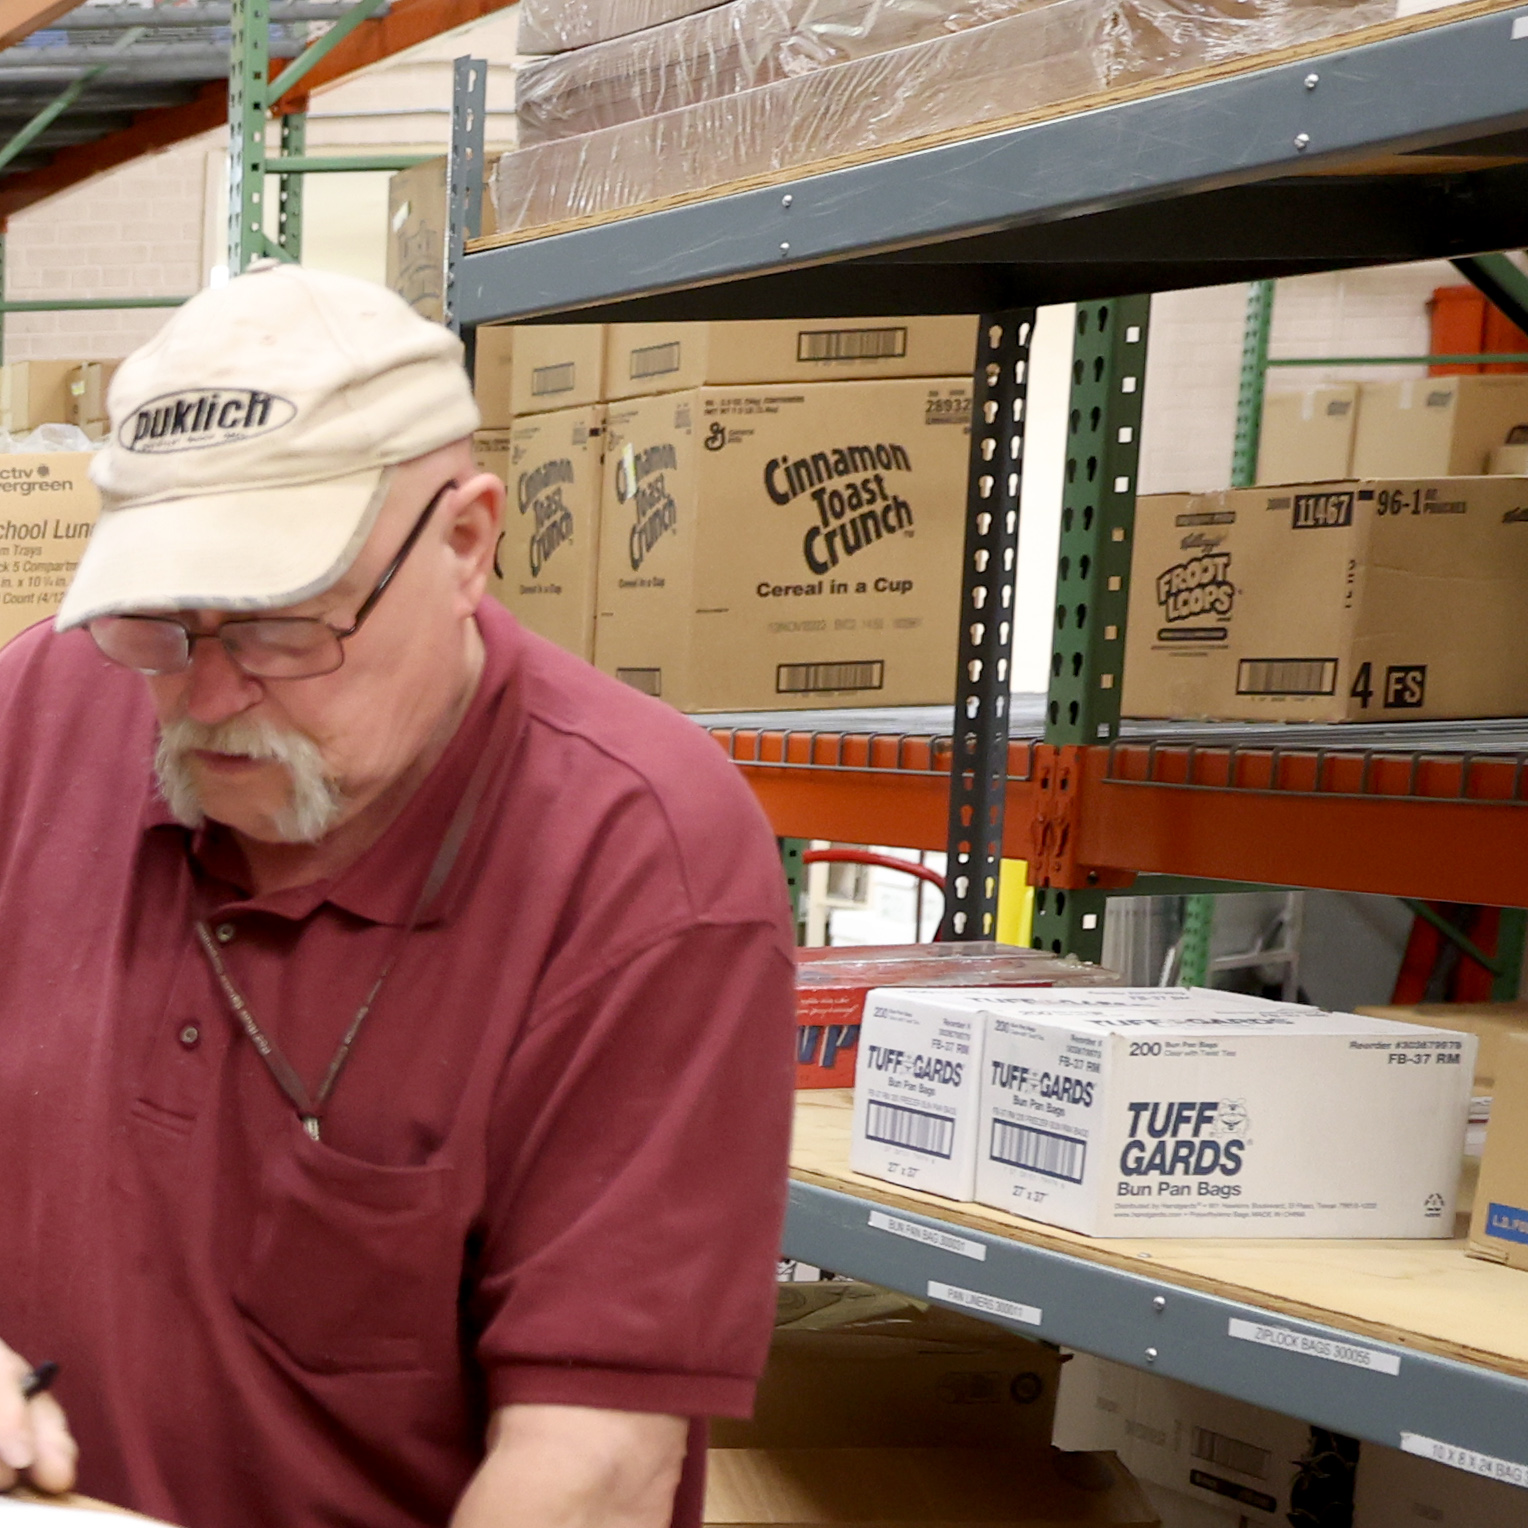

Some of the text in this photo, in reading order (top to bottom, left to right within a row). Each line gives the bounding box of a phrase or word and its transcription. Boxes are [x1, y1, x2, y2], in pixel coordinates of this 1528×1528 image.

[764, 443, 912, 506] Cinnamon
[811, 473, 889, 529] Toast
[530, 506, 573, 578] Crunch
[630, 493, 676, 571] Crunch
[803, 495, 914, 575] Crunch
[13, 545, 42, 557] Trays
[13, 561, 20, 572] 5
[756, 577, 914, 598] Cereal in a Cup
[1157, 553, 1231, 604] FROOT
[3, 593, 34, 604] Count
[1165, 582, 1235, 622] LOOPS
[1351, 661, 1425, 709] 4 FS
[1129, 1042, 1162, 1057] 200
[1349, 1041, 1391, 1051] Reorder
[1387, 1053, 1461, 1065] FB-37 RM
[868, 1045, 963, 1088] TUFF GARDS
[888, 1076, 936, 1098] Bun Pan Bags
[991, 1061, 1095, 1107] TUFF GARDS
[1013, 1095, 1065, 1117] Bun Pan Bags
[1128, 1101, 1219, 1139] TUFF
[1120, 1139, 1245, 1177] GARDS
[1117, 1182, 1242, 1199] Bun Pan Bags
[1255, 1327, 1298, 1346] ZIPLOCK
[1301, 1337, 1331, 1356] BAGS
[1496, 1461, 1522, 1481] BAG
